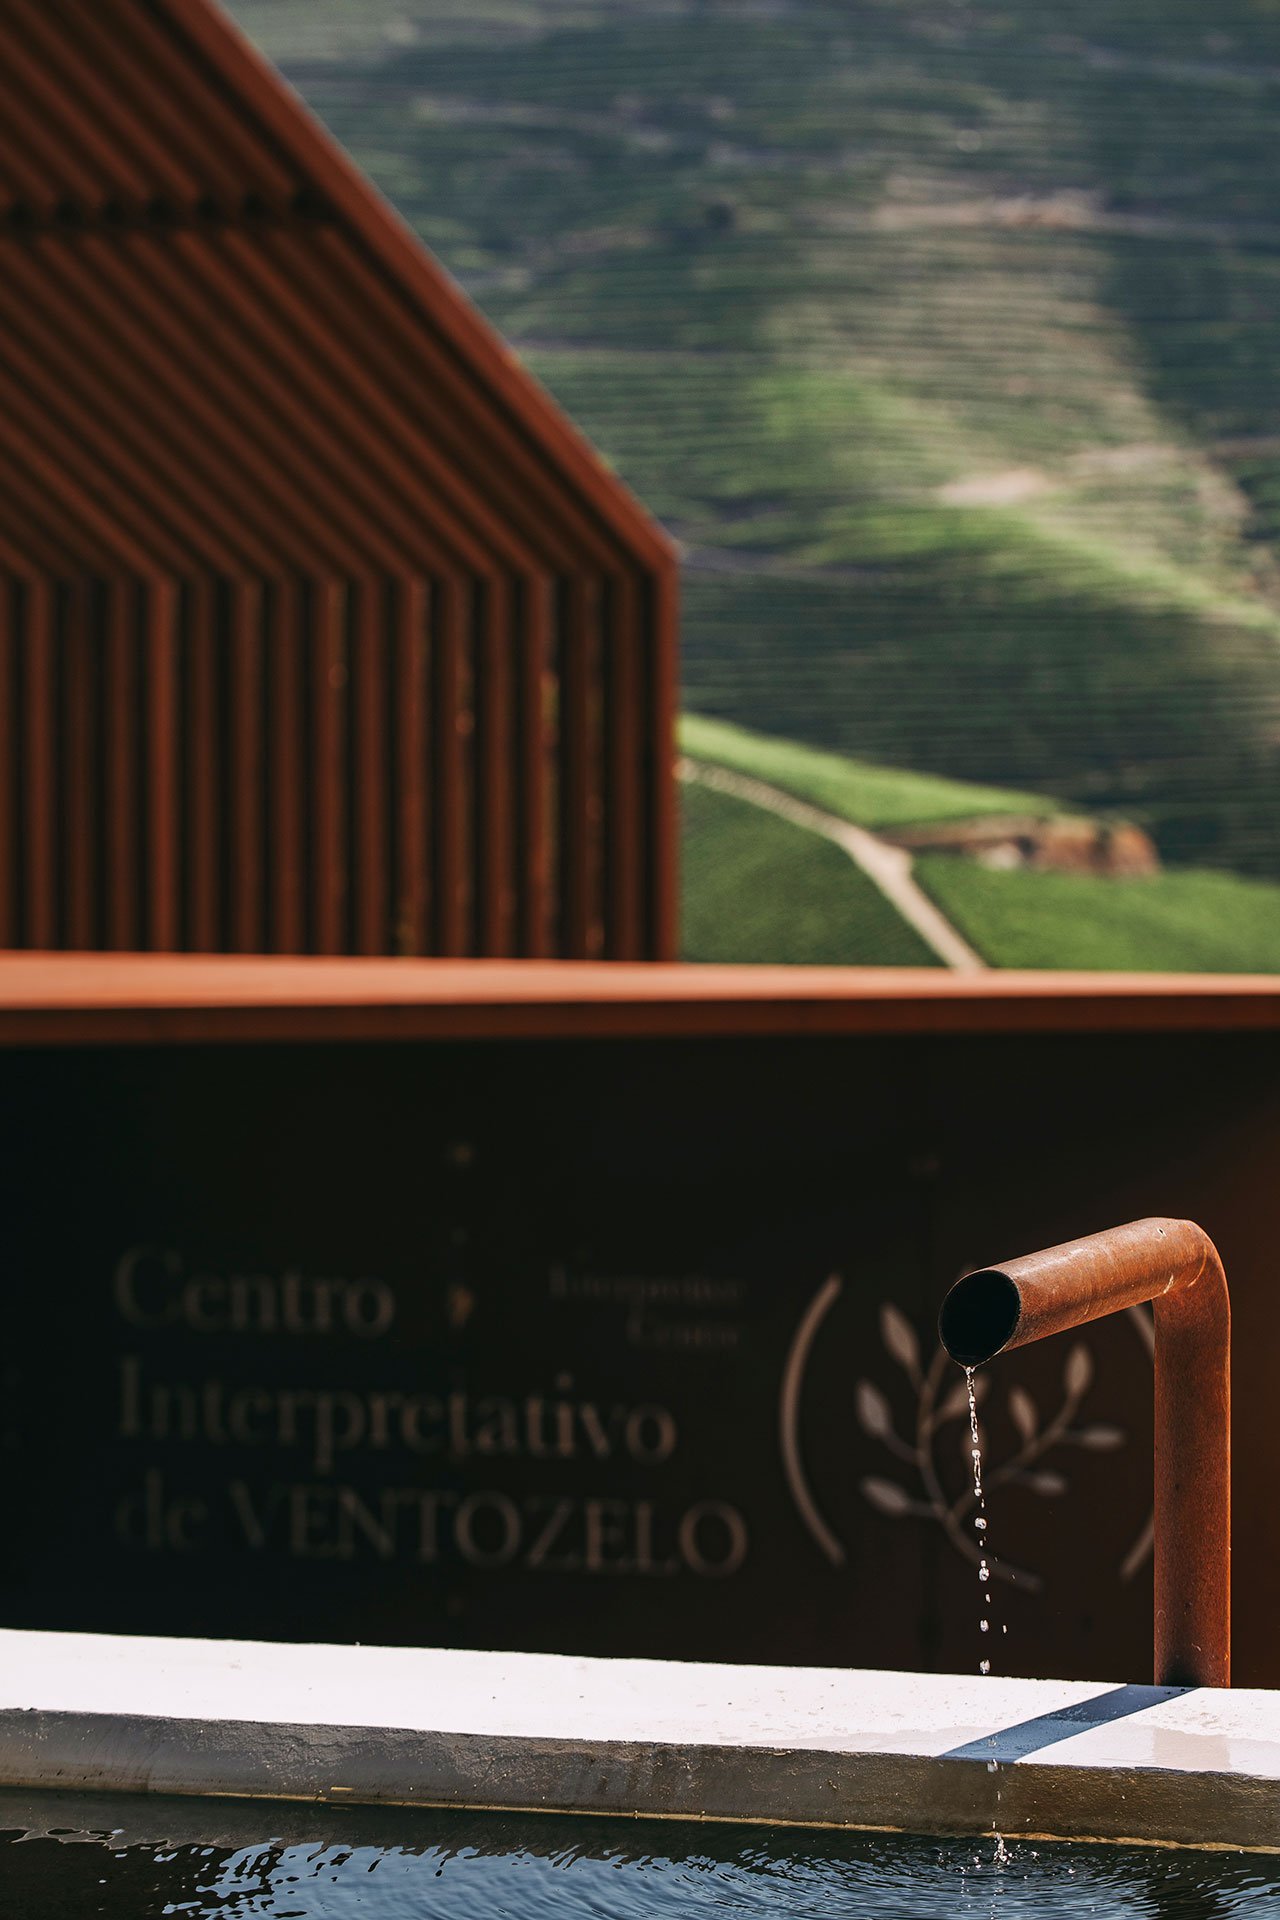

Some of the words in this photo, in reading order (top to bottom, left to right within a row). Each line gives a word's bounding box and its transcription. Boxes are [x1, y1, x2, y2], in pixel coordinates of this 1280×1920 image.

[112, 1244, 396, 1338] Centro
[117, 1355, 678, 1475] Interpretativo
[114, 1467, 208, 1551] de
[228, 1479, 749, 1578] VENTOZELO
